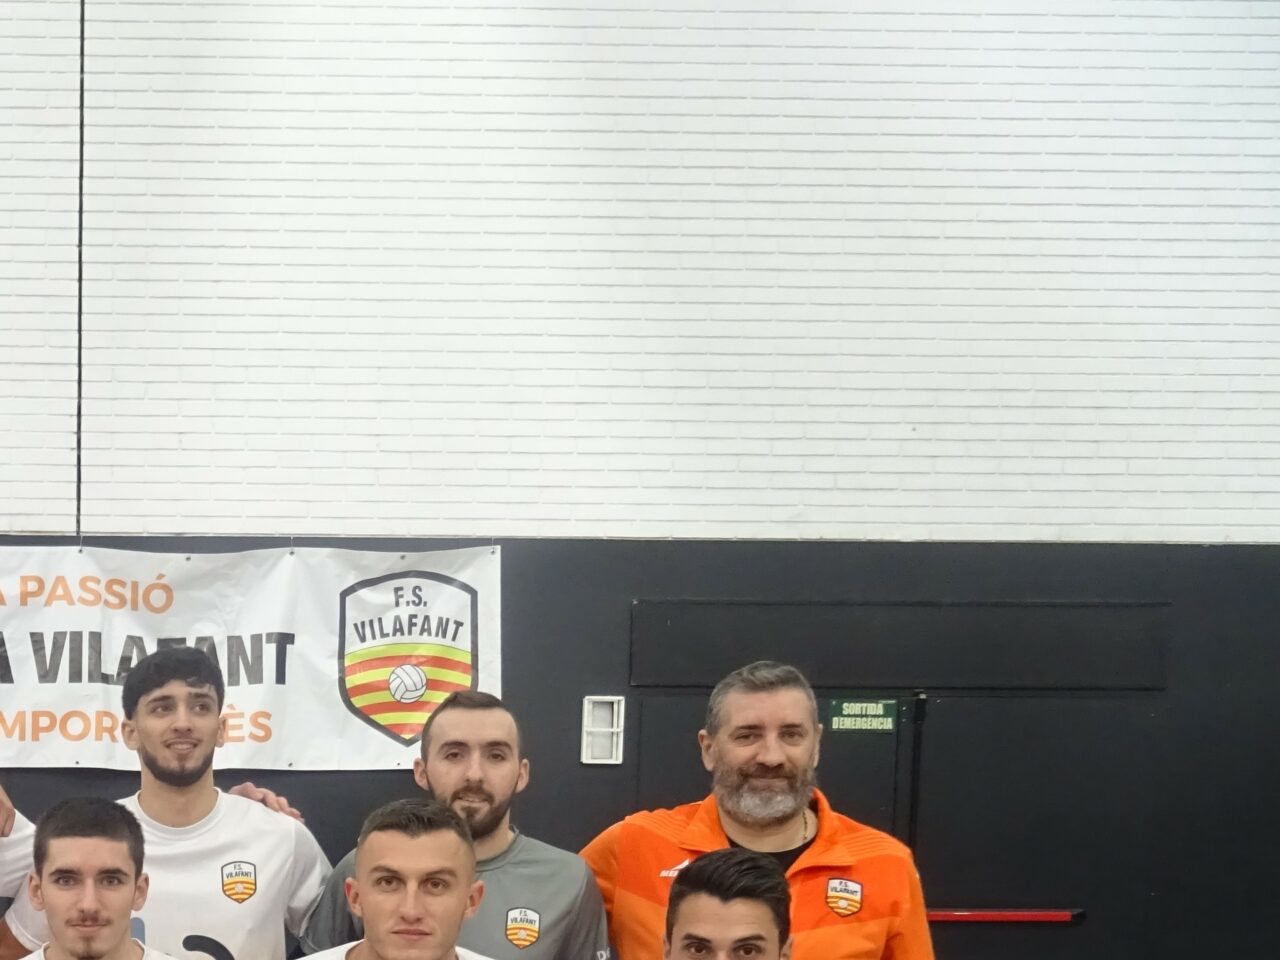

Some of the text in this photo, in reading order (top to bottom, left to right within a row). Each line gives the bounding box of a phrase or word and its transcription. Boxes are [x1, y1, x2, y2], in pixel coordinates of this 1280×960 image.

[18, 573, 176, 615] PASSIÓ
[393, 585, 428, 608] F.S.
[352, 613, 465, 643] VILAFANT
[28, 630, 296, 687] VILANT
[842, 703, 884, 715] SORTIDA
[225, 871, 252, 879] VILAFANT
[510, 917, 537, 925] VILAFANT
